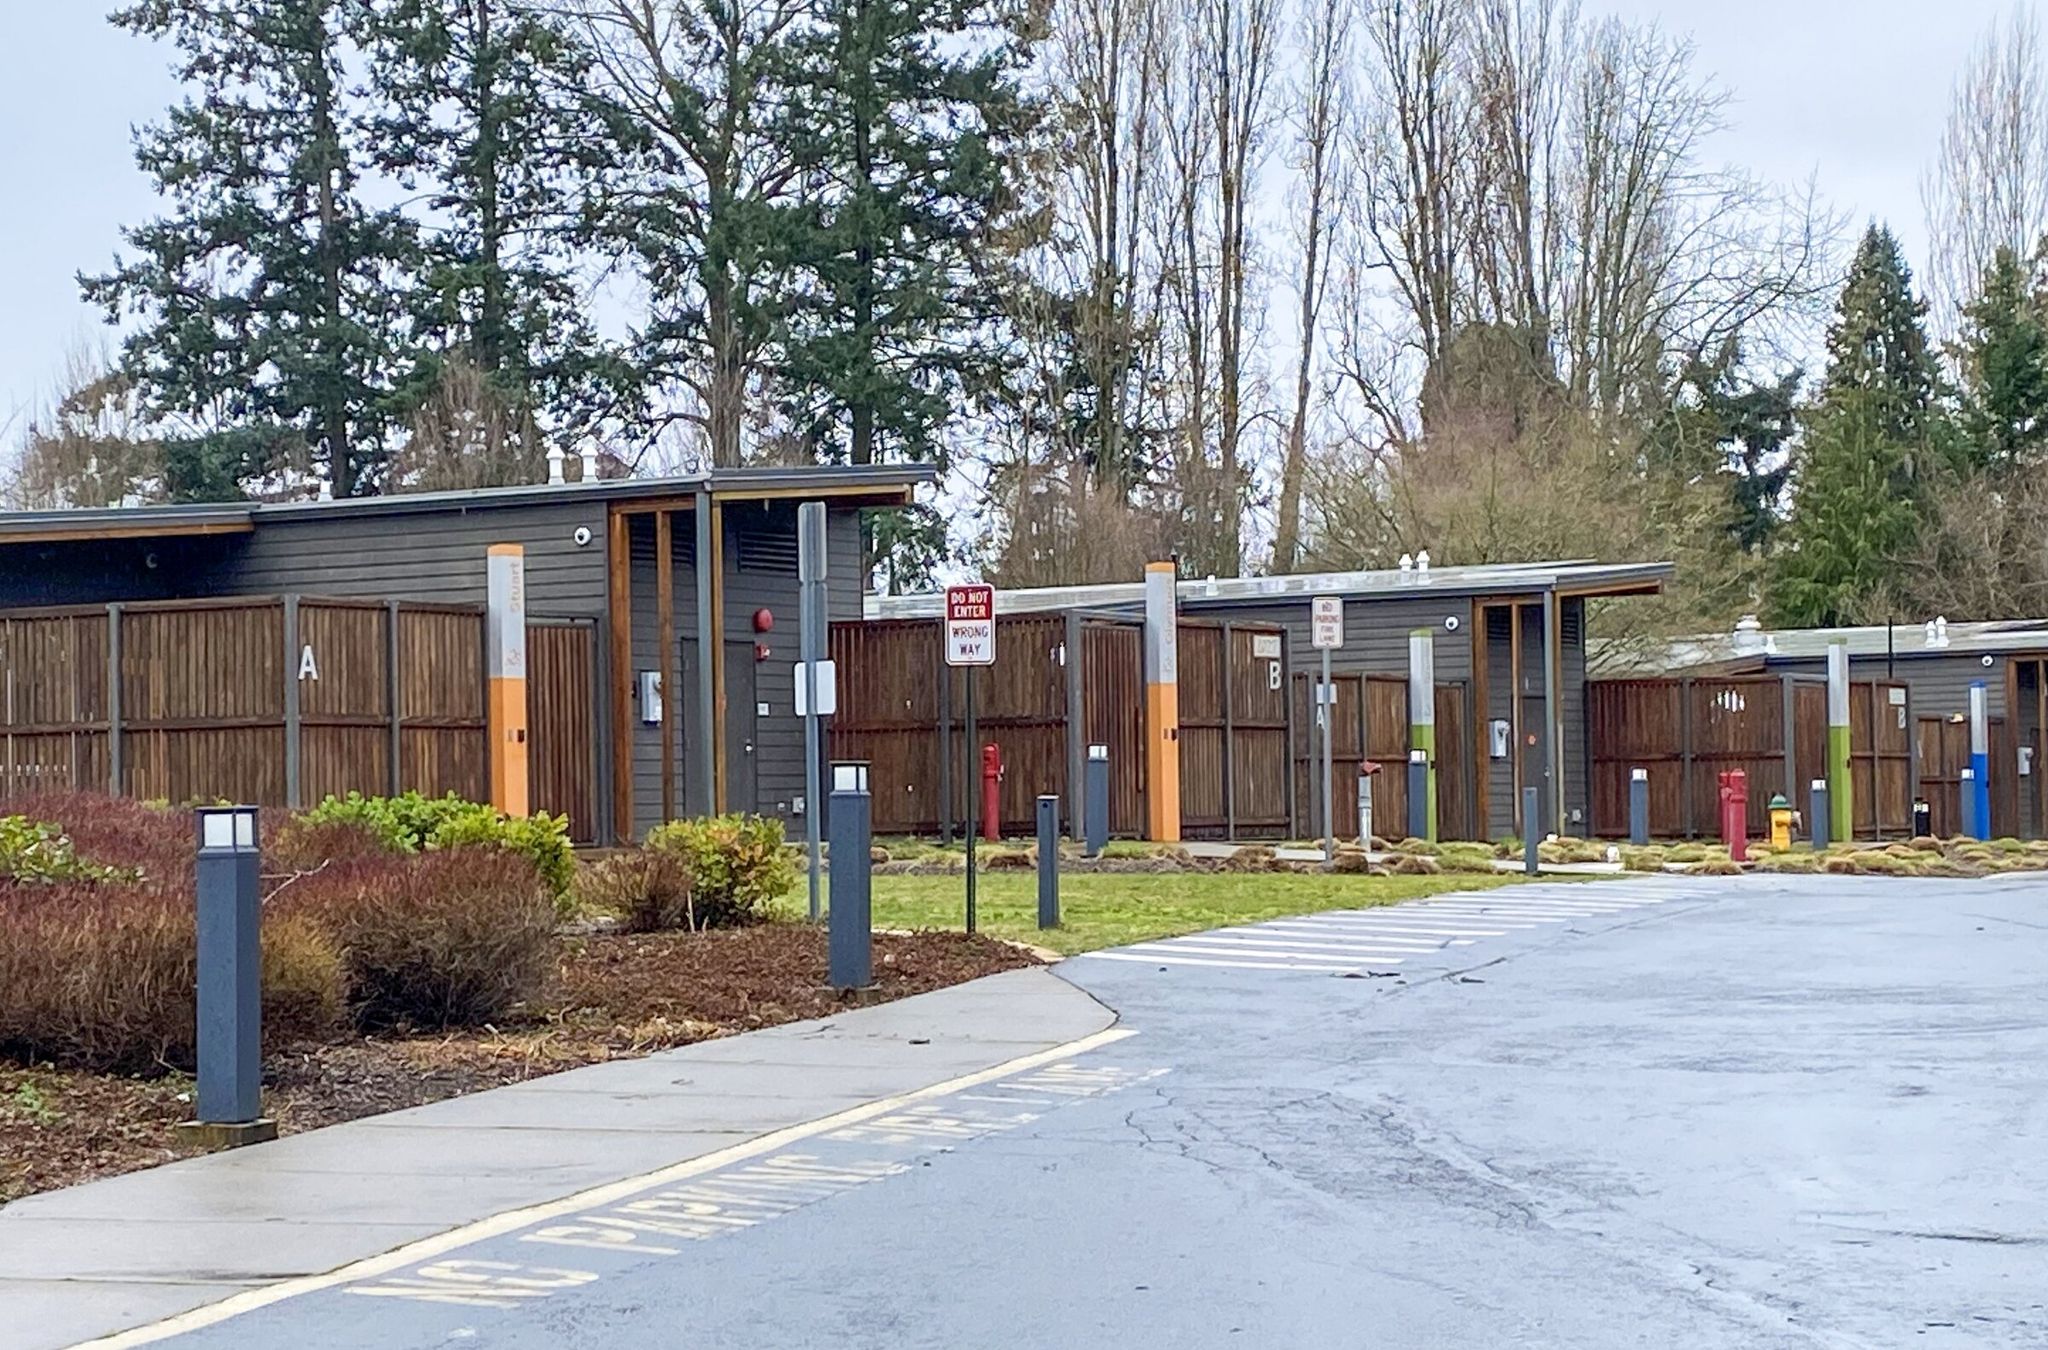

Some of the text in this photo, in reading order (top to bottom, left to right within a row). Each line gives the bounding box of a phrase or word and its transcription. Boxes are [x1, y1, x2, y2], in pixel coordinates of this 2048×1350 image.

[951, 591, 988, 604] DO NOT
[954, 605, 986, 618] ENTER
[1322, 601, 1333, 612] NO
[952, 626, 988, 638] WRONG
[960, 643, 981, 656] WAY
[298, 645, 318, 680] A
[1270, 661, 1281, 689] B
[342, 1259, 600, 1309] NO
[519, 1154, 912, 1256] PARKING
